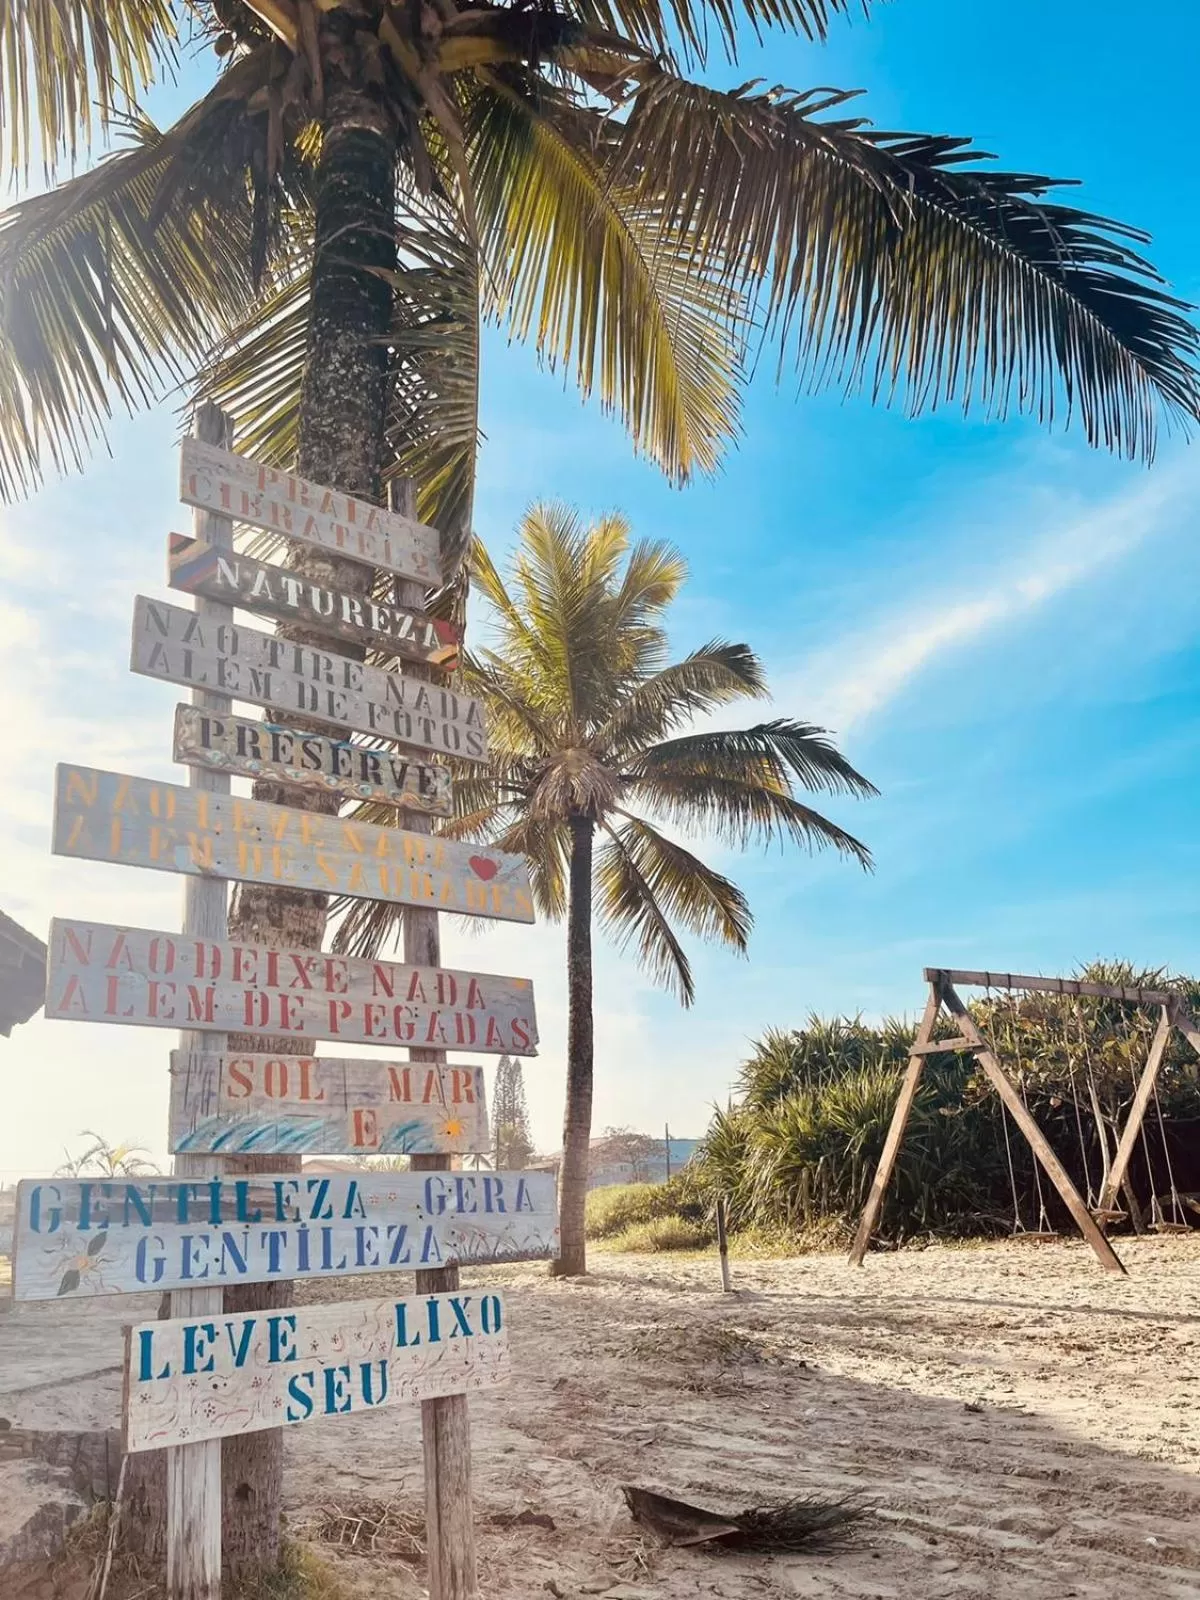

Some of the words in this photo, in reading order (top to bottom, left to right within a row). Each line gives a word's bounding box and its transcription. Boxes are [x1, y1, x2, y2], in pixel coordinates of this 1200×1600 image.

[215, 557, 441, 648] NATUREZA
[263, 638, 364, 692] TIRE
[386, 675, 483, 729] NADA
[297, 681, 349, 721] DE
[200, 718, 439, 798] PRESERVE
[244, 990, 305, 1032] DE
[328, 999, 532, 1051] PEGADAS
[371, 964, 487, 1020] NADA
[226, 1058, 326, 1101] SOL
[387, 1066, 476, 1104] MAR
[353, 1108, 379, 1149] E
[424, 1175, 536, 1217] GERA
[137, 1314, 298, 1383] LEVE
[286, 1358, 390, 1423] SEU
